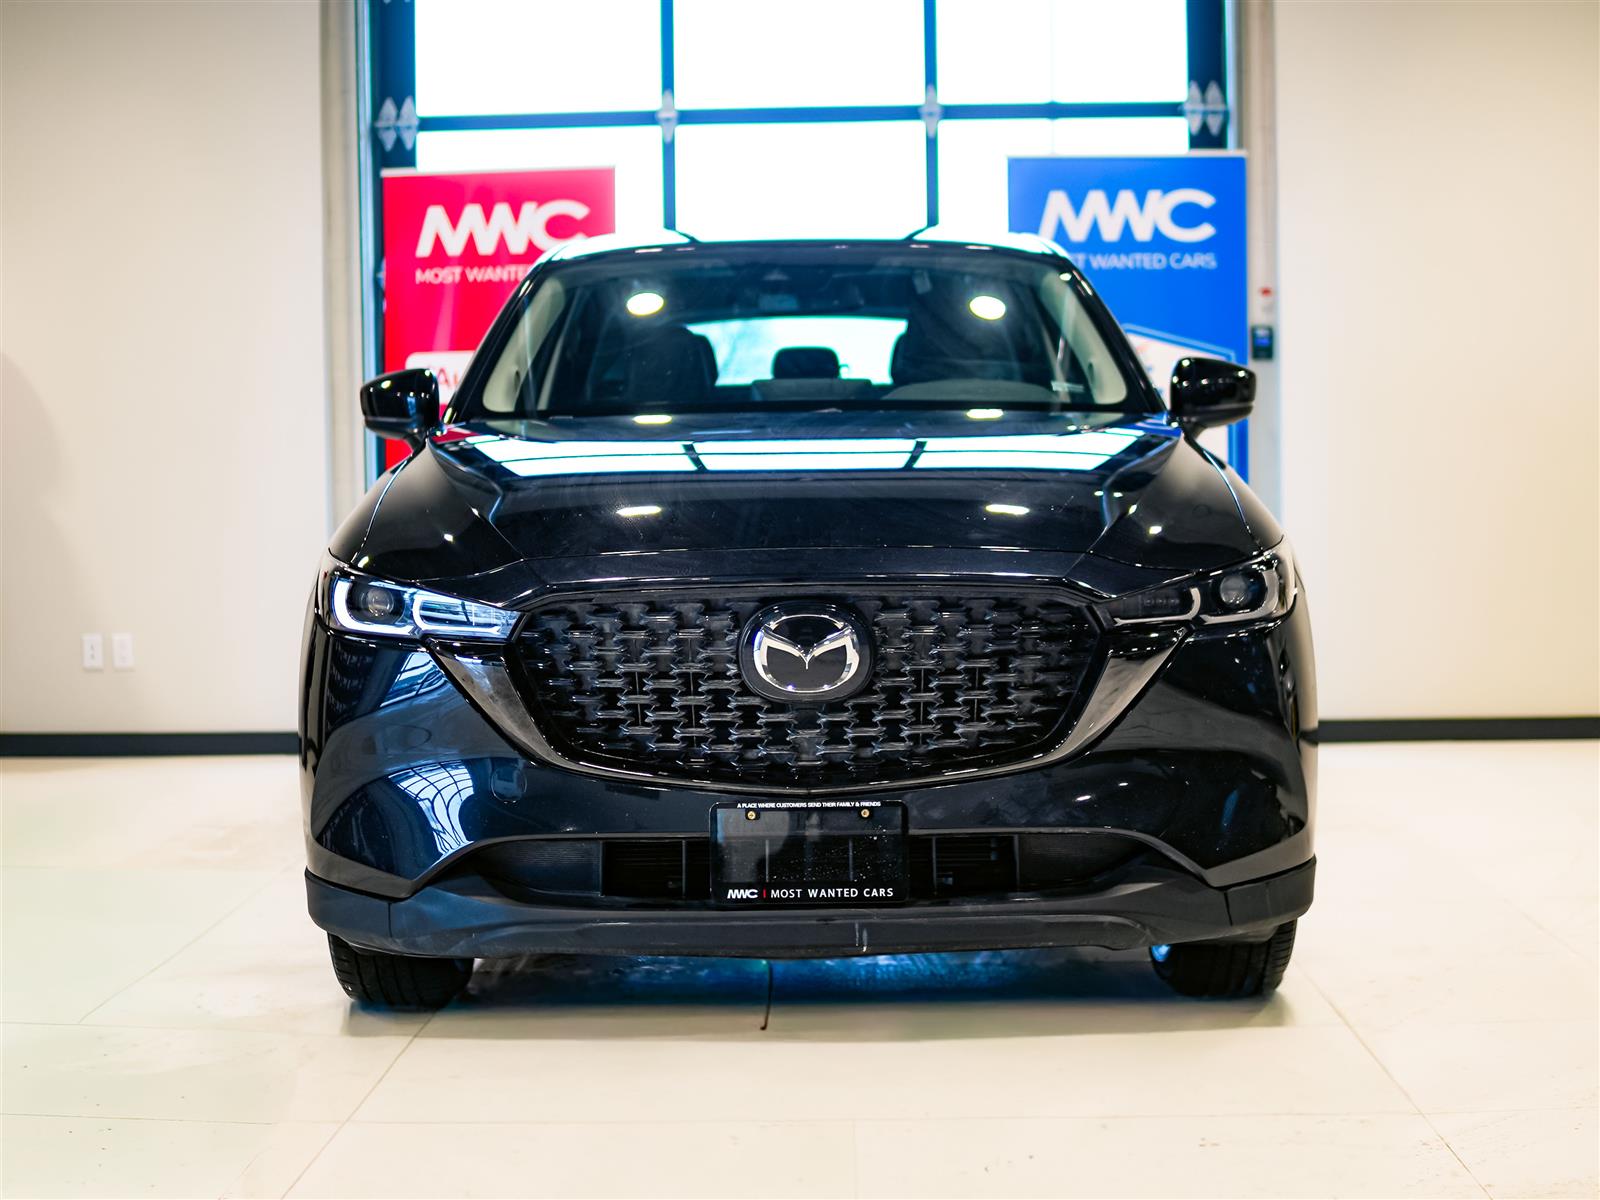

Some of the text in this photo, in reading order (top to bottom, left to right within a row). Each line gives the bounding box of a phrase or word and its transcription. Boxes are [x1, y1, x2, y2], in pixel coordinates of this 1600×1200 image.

[1038, 188, 1217, 242] MWC
[415, 199, 590, 257] MWC
[1088, 252, 1168, 270] WANTED
[1169, 252, 1218, 270] CARS
[415, 263, 530, 285] MOST WANTE
[727, 888, 894, 899] MWC MOST WANTED CARS
